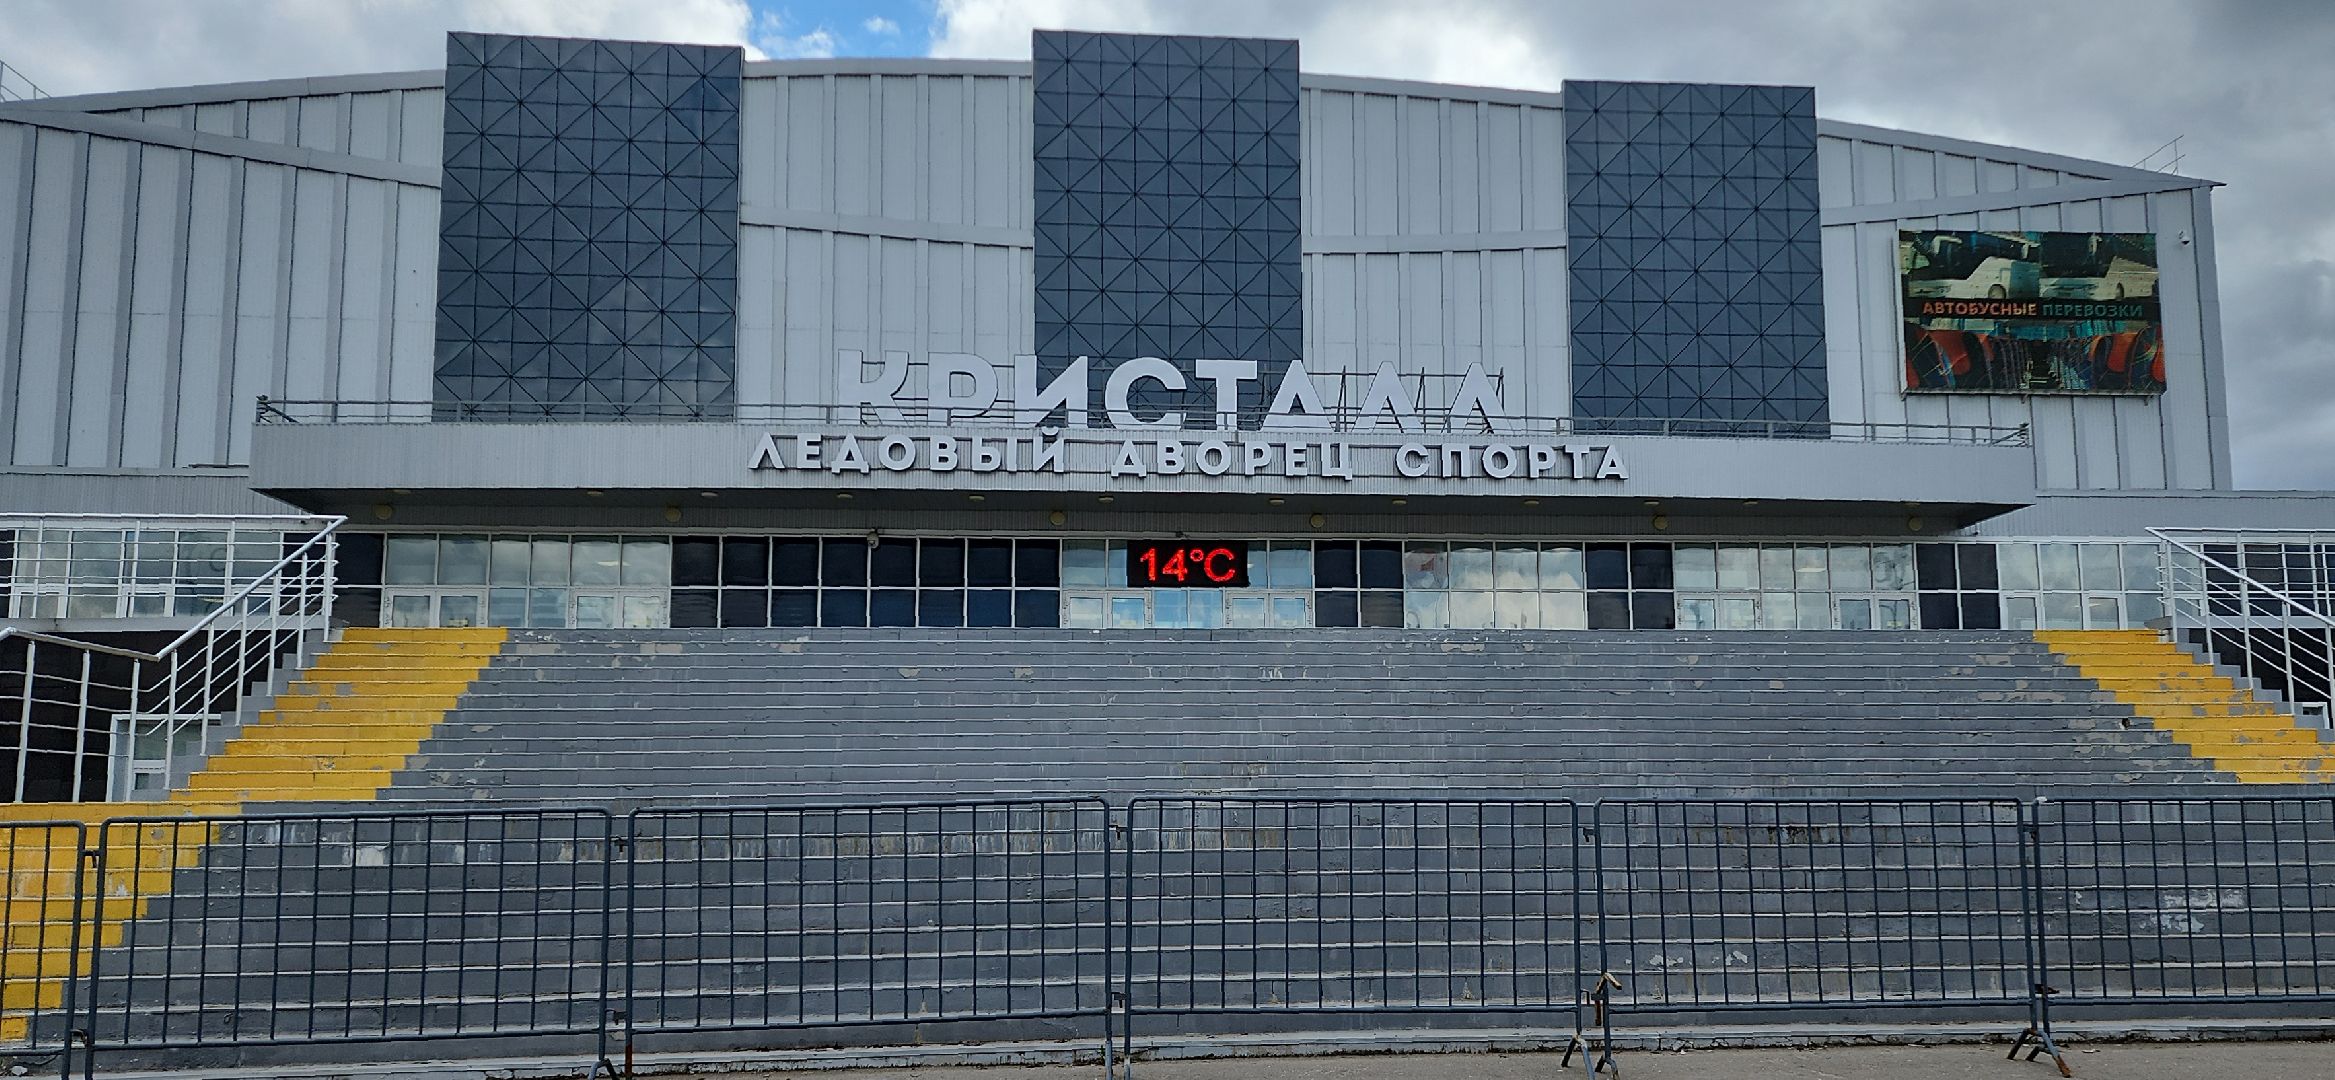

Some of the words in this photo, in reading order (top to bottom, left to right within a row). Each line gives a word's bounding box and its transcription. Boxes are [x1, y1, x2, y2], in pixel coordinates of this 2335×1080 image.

[1923, 302, 2038, 316] АВТОБУСНЫЕ
[2042, 303, 2143, 317] ПЕРЕВОЗКИ
[837, 350, 1514, 433] КРИСТАЛЛ
[749, 427, 1066, 474] ЛЕДОВЫЙ
[1111, 438, 1353, 480] ДВОРЕЦ
[1395, 444, 1629, 479] СПОРТА
